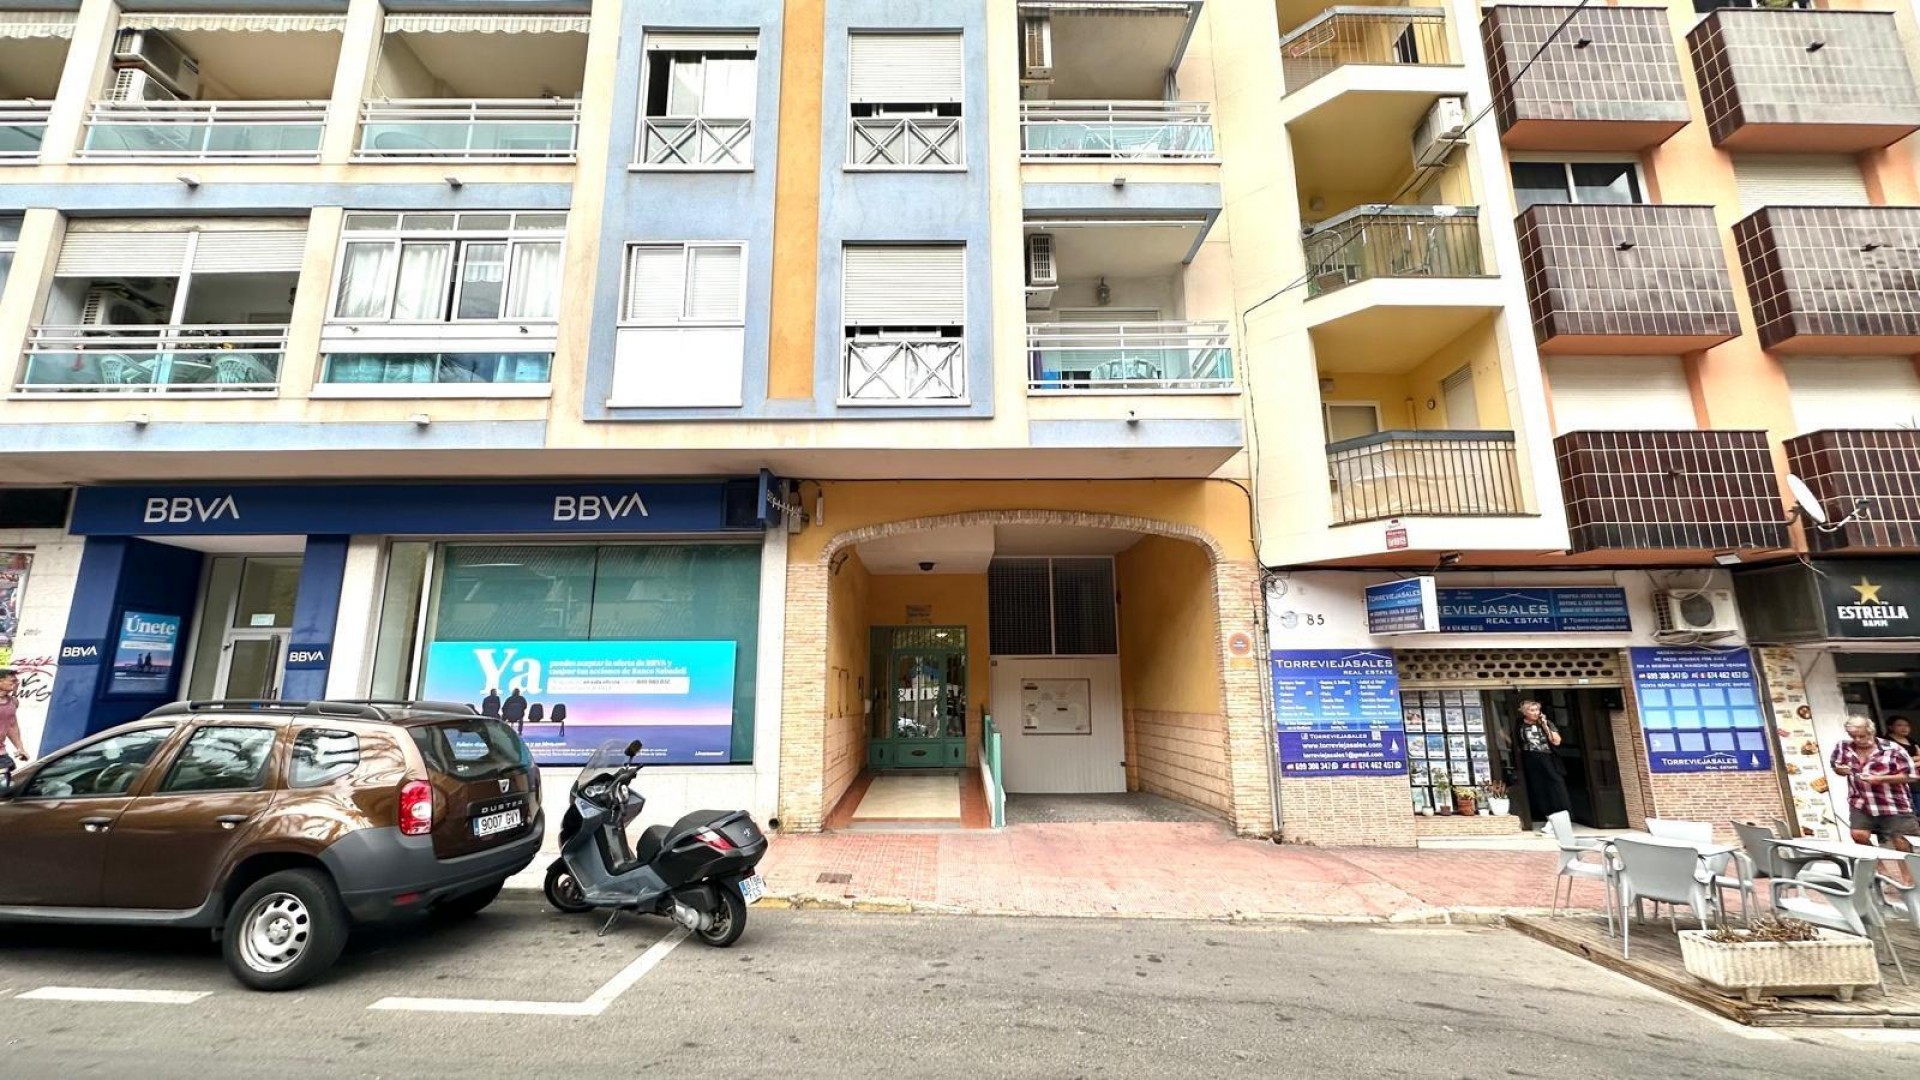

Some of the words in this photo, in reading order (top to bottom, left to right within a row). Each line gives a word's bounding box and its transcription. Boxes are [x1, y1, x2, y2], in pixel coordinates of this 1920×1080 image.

[143, 494, 240, 523] BBVA
[553, 492, 649, 521] BBVA
[1368, 588, 1421, 603] TORREVIEJASALES
[1437, 605, 1549, 615] REVIEJASALES
[1836, 605, 1909, 619] ESTRELLA
[126, 614, 176, 636] Únete
[1306, 614, 1325, 626] 85
[62, 646, 98, 658] BBVA
[289, 650, 324, 662] BBVA
[1275, 659, 1393, 668] TORREVIEJASALES
[473, 648, 543, 695] Ya
[1661, 758, 1738, 766] TORREVIEJASALES
[481, 799, 523, 814] DUSTER
[481, 814, 502, 831] 9007
